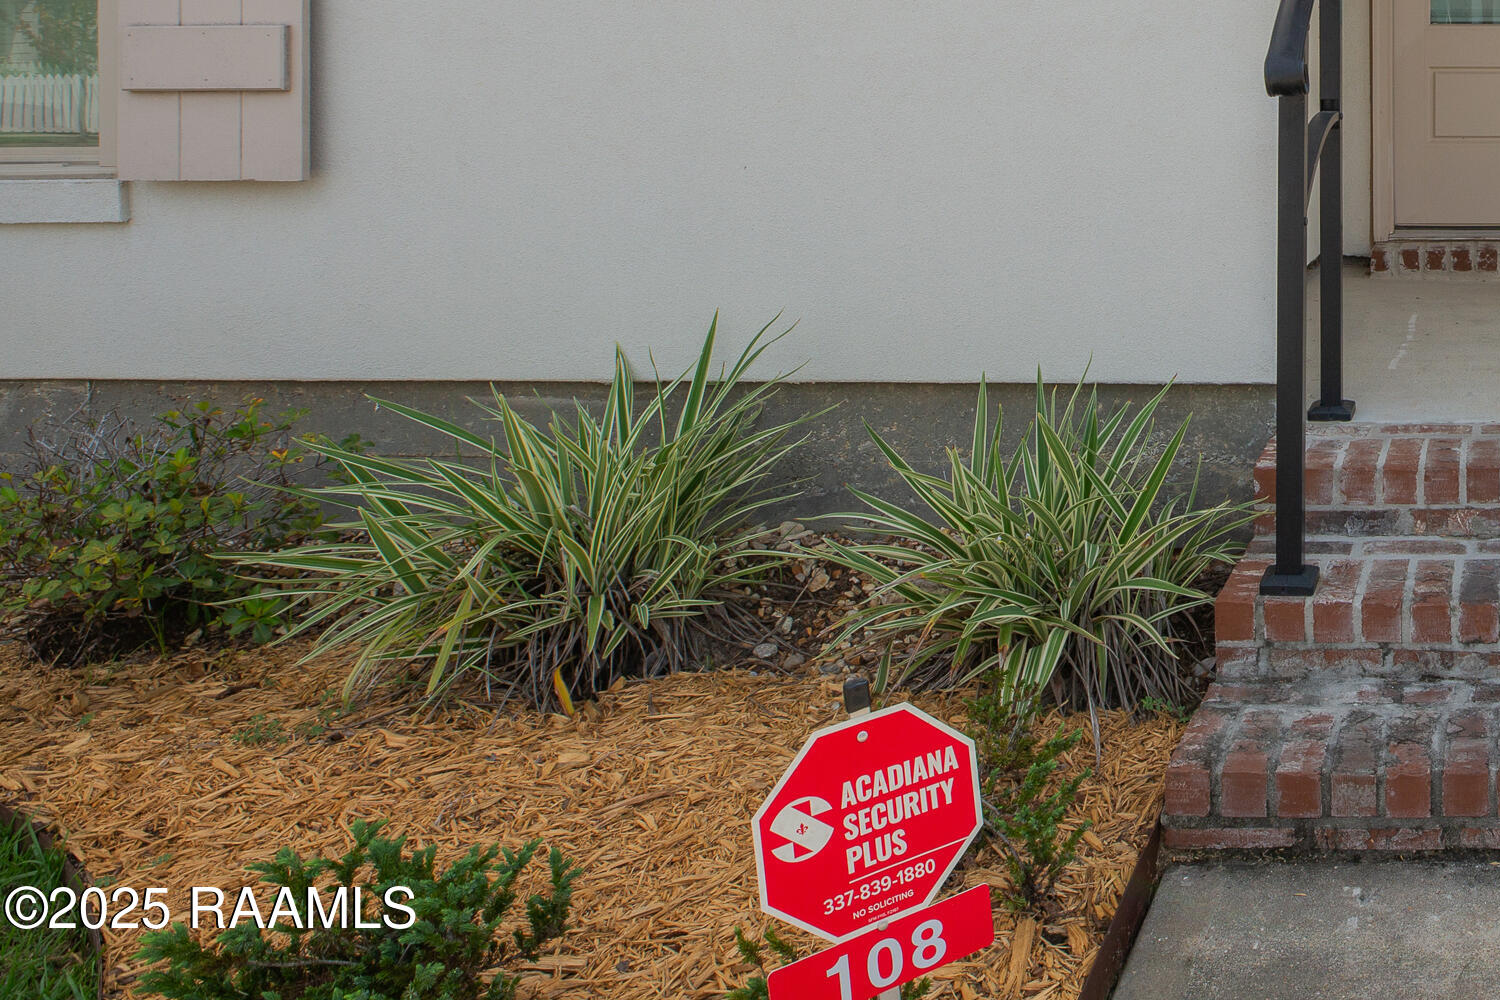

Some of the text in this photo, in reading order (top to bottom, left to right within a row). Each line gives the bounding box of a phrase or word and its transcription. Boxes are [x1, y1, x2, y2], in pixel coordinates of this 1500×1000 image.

[841, 746, 959, 809] ACADIANA
[843, 778, 954, 840] SECURITY
[845, 829, 908, 874] PLUS
[823, 858, 936, 915] 337-839-1880
[852, 908, 867, 920] NO
[867, 889, 915, 914] SOLICITING
[826, 918, 947, 1000] 108
